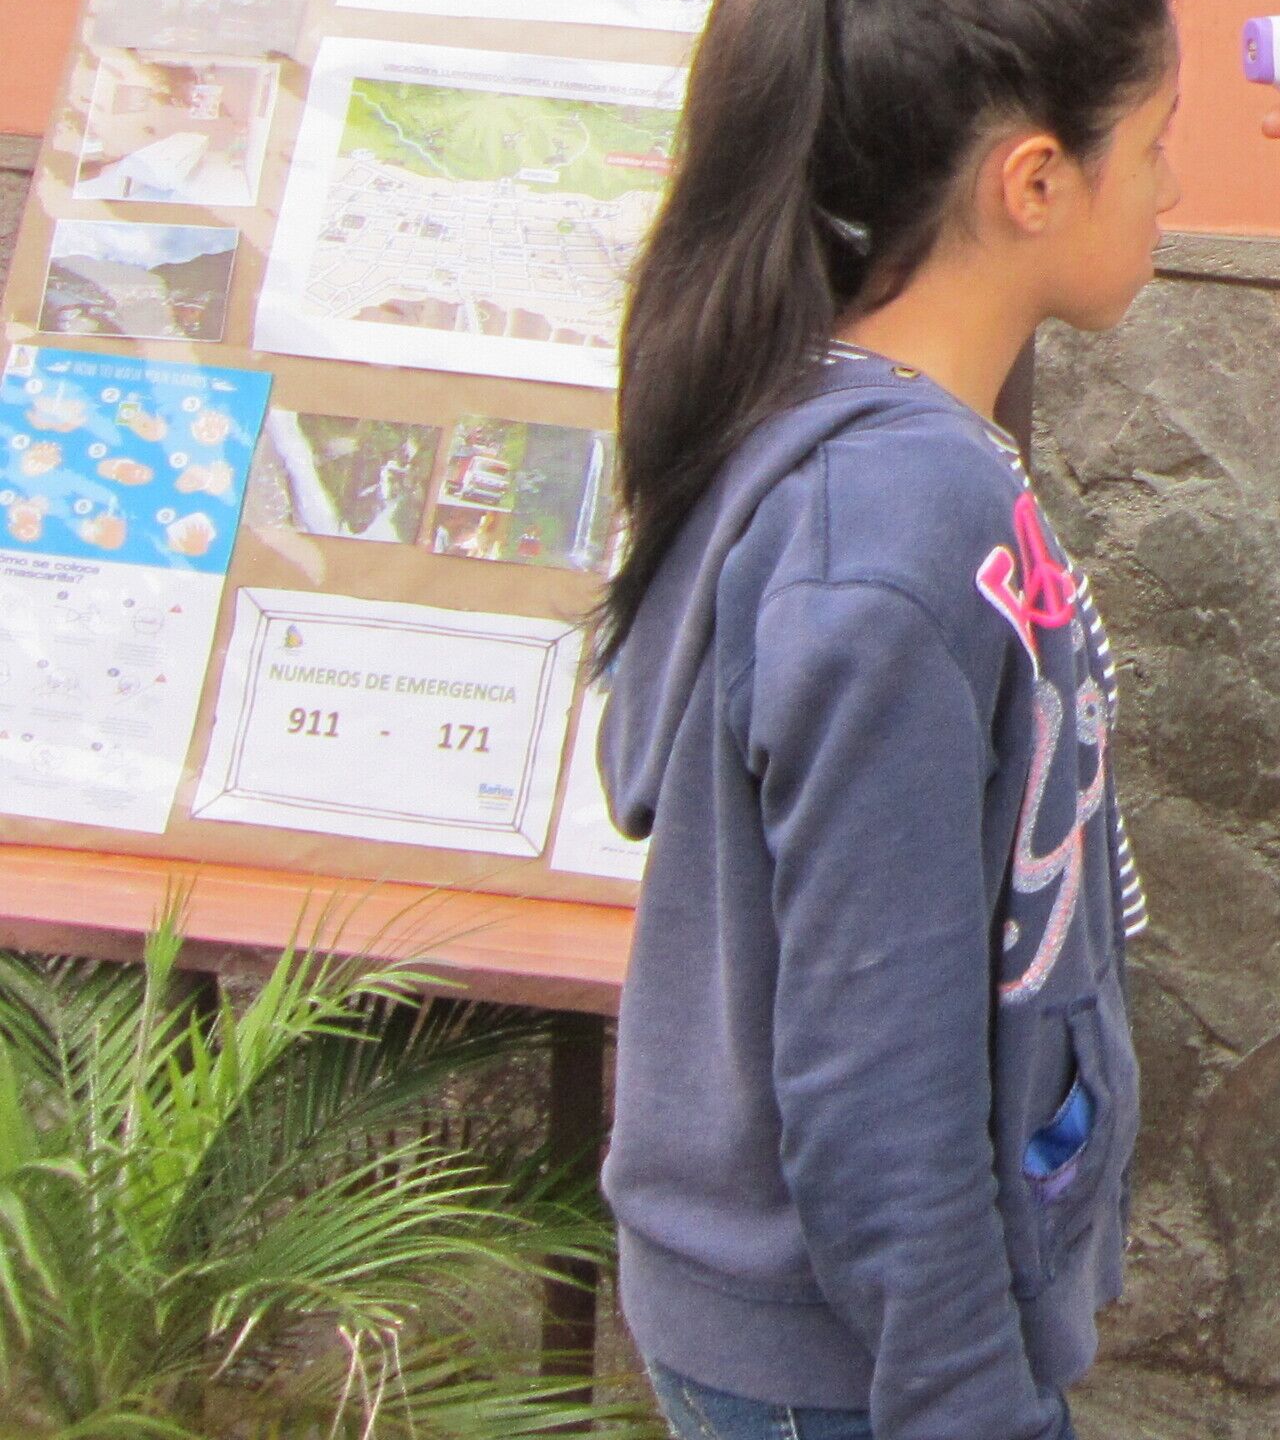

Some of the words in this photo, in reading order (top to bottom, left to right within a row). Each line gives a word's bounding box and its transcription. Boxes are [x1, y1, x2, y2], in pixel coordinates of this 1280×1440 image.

[365, 672, 392, 691] DE
[395, 675, 517, 704] EMERGENCIA
[287, 708, 340, 737] 911
[437, 722, 490, 753] 171
